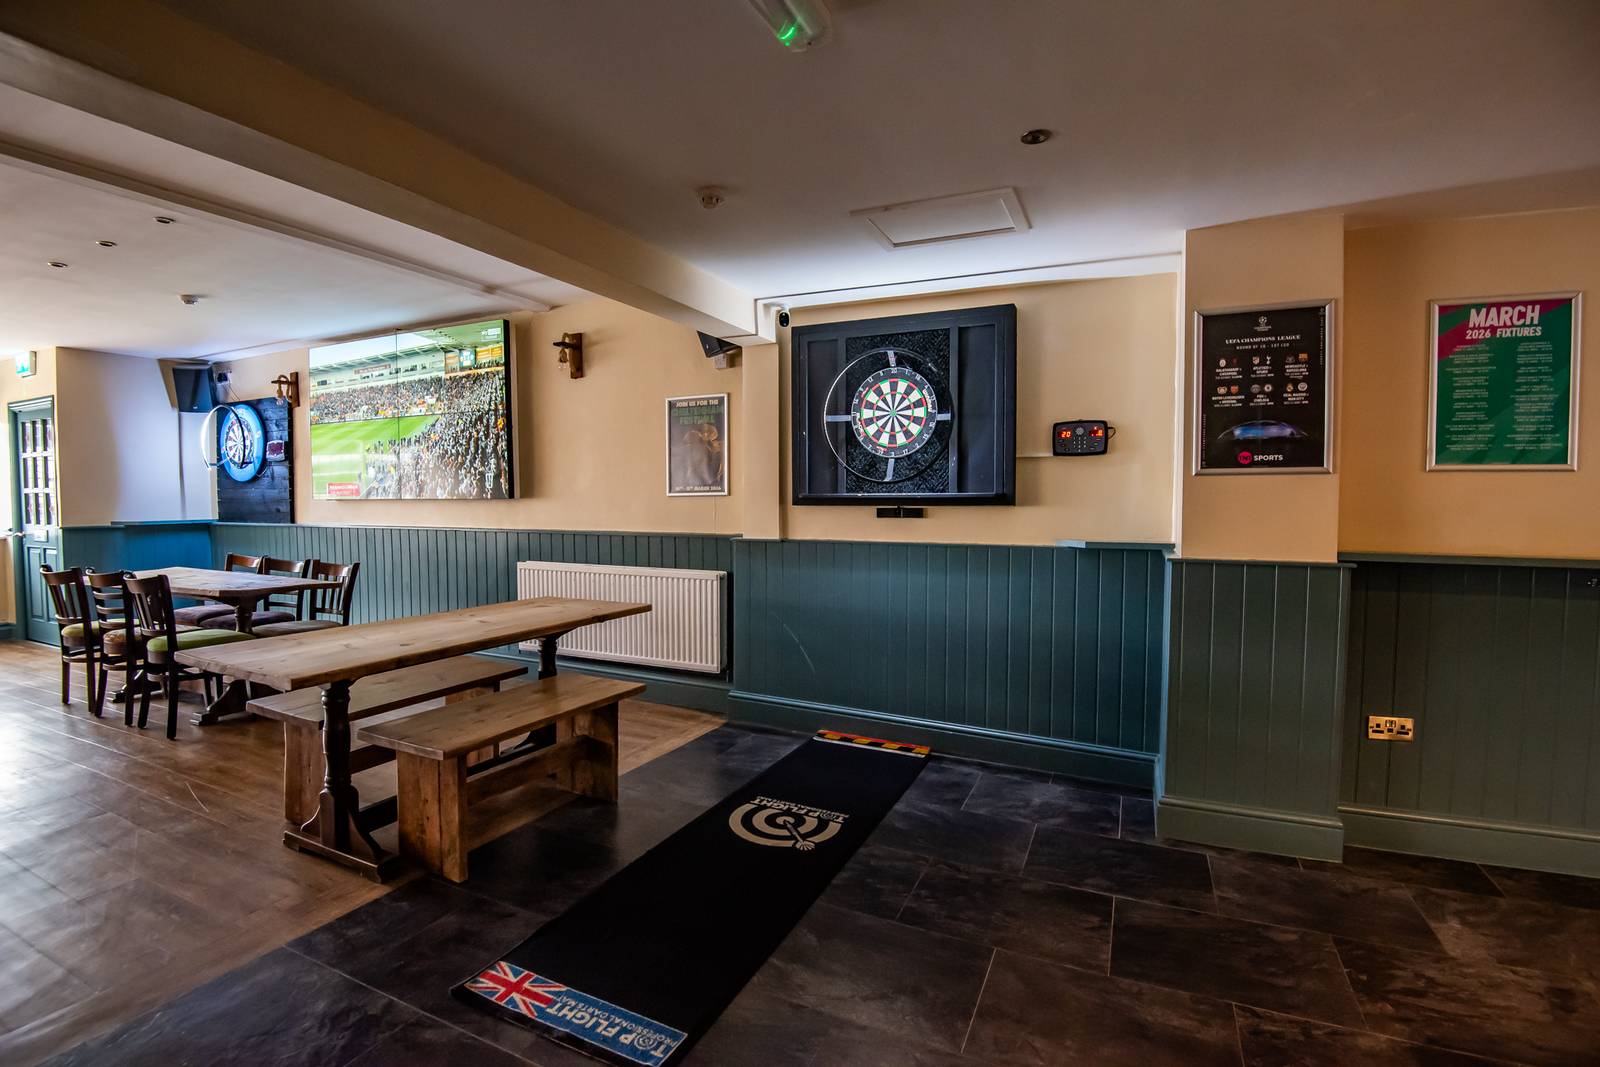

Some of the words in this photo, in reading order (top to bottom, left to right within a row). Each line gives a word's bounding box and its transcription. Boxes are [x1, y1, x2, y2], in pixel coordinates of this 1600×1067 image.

[1468, 305, 1541, 328] MARCH
[1241, 336, 1276, 344] CHAMPIONS
[1465, 329, 1491, 340] 2026
[1496, 326, 1542, 338] FIXTURES
[750, 799, 808, 815] FLIGHT
[545, 1002, 620, 1038] FLIGHT
[578, 1002, 608, 1020] DARTS
[608, 1014, 678, 1048] PROFESSIONAL
